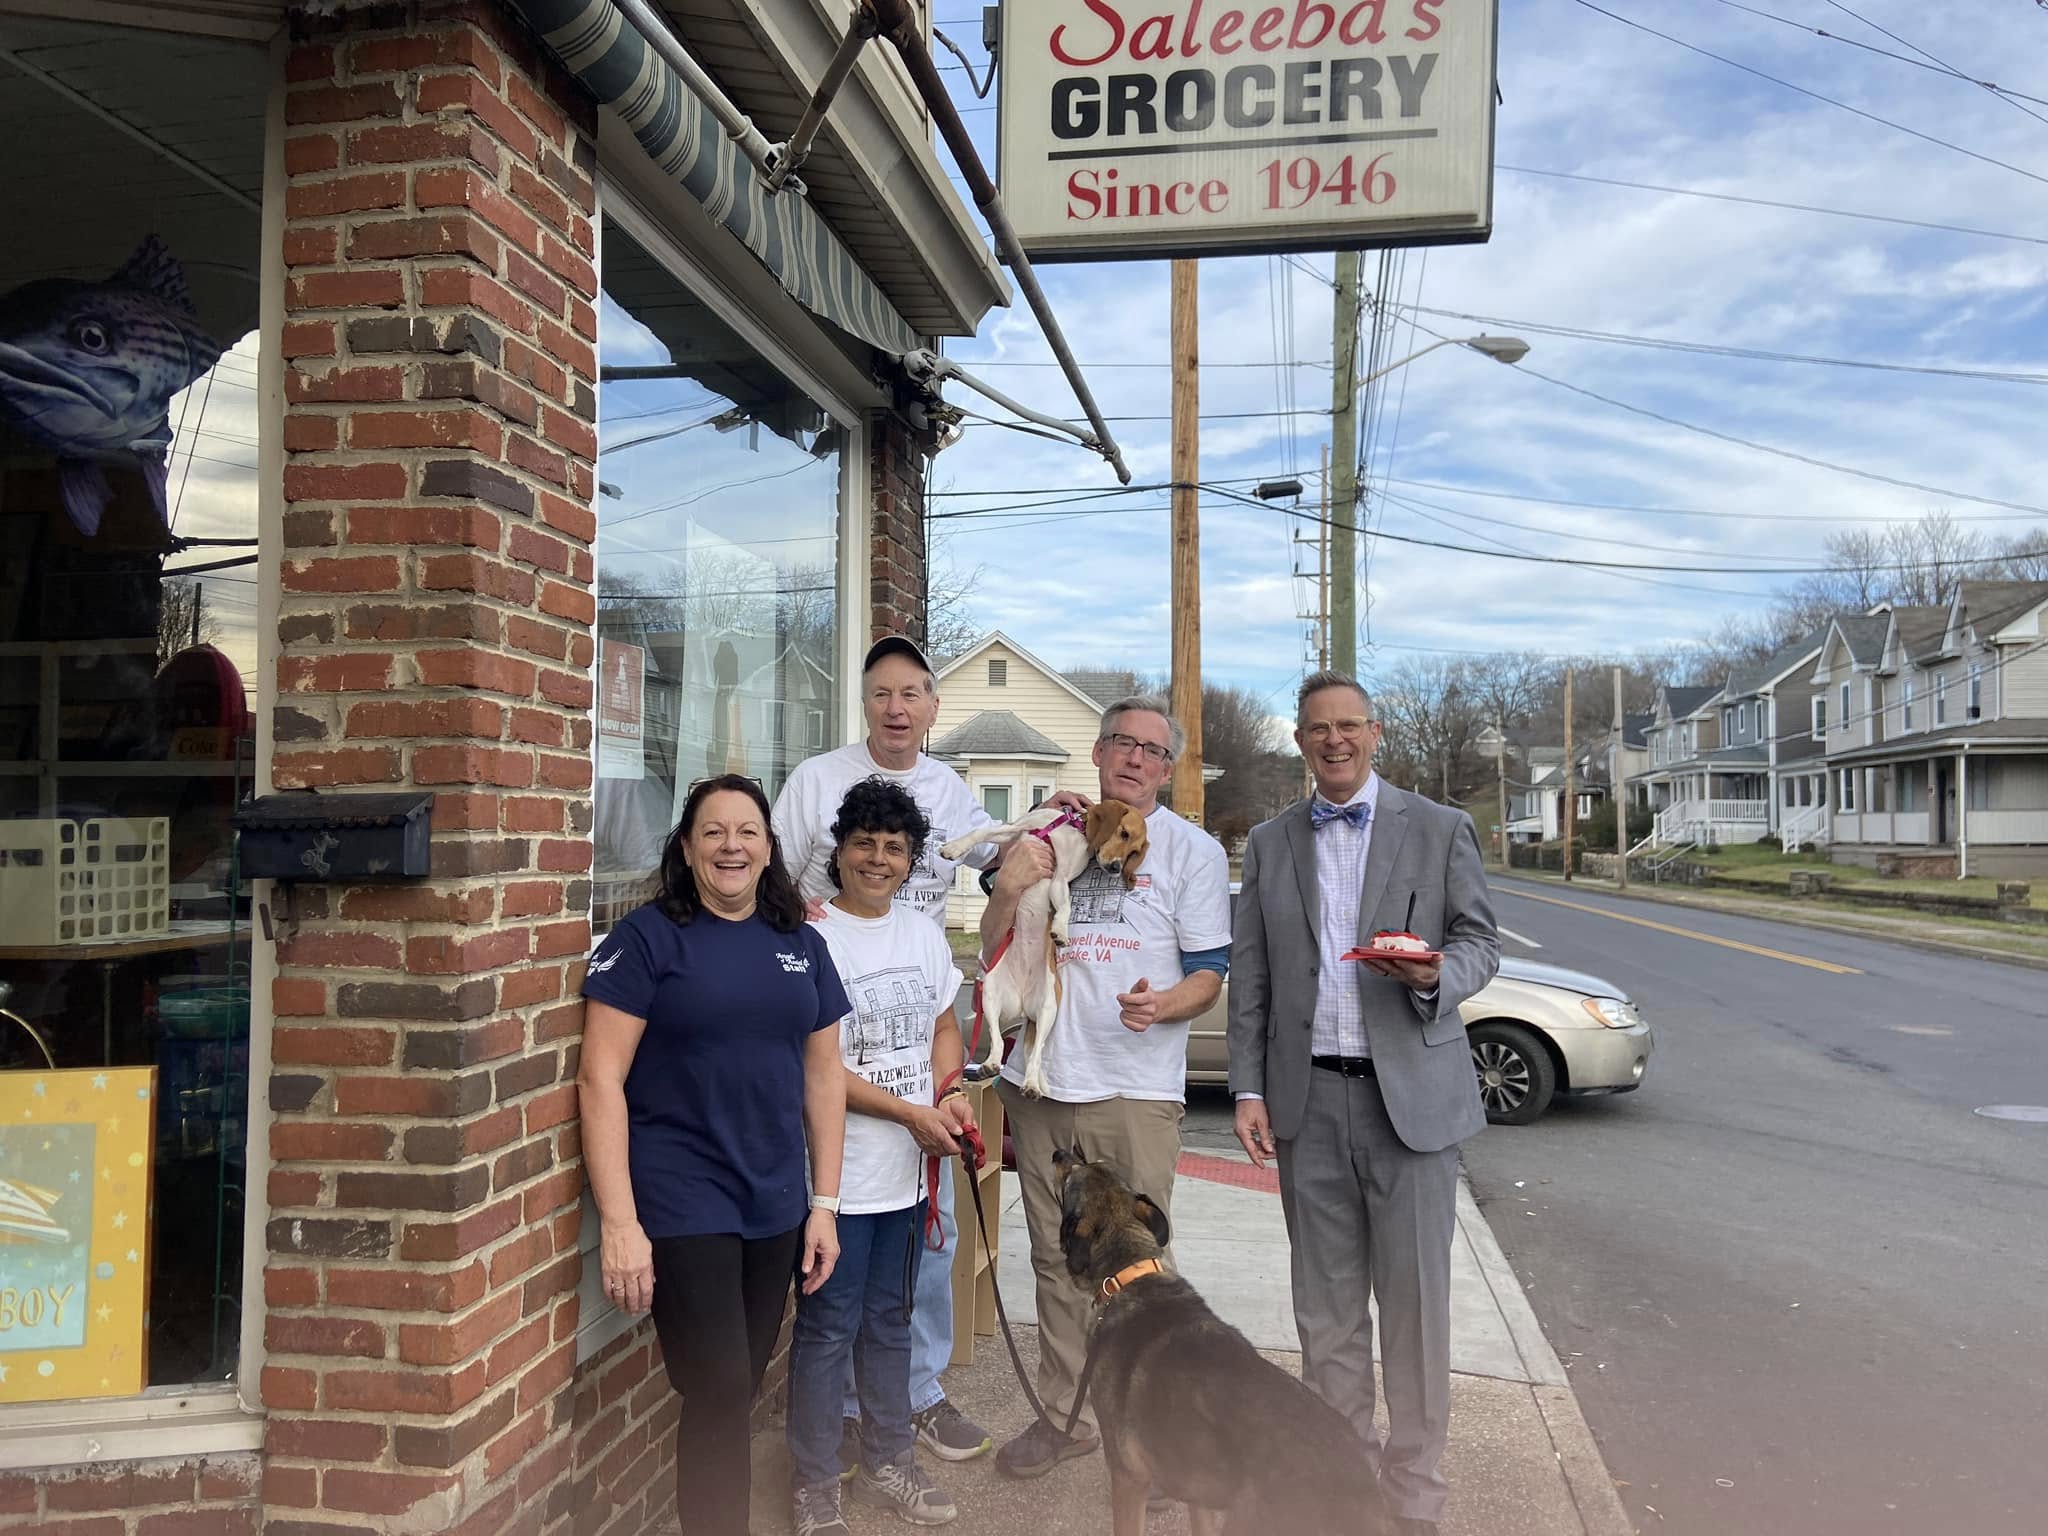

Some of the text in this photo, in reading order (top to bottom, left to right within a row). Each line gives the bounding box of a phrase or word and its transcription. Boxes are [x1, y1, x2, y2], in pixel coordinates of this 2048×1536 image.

[1050, 0, 1444, 66] Saleebas
[1051, 53, 1439, 139] GROCERY
[1067, 152, 1396, 220] Since 1946
[601, 719, 640, 735] NOW OPEN
[1094, 934, 1140, 950] Avenue
[1096, 949, 1111, 963] VA
[869, 1063, 917, 1084] TAZEWELL
[0, 1284, 75, 1331] BOY
